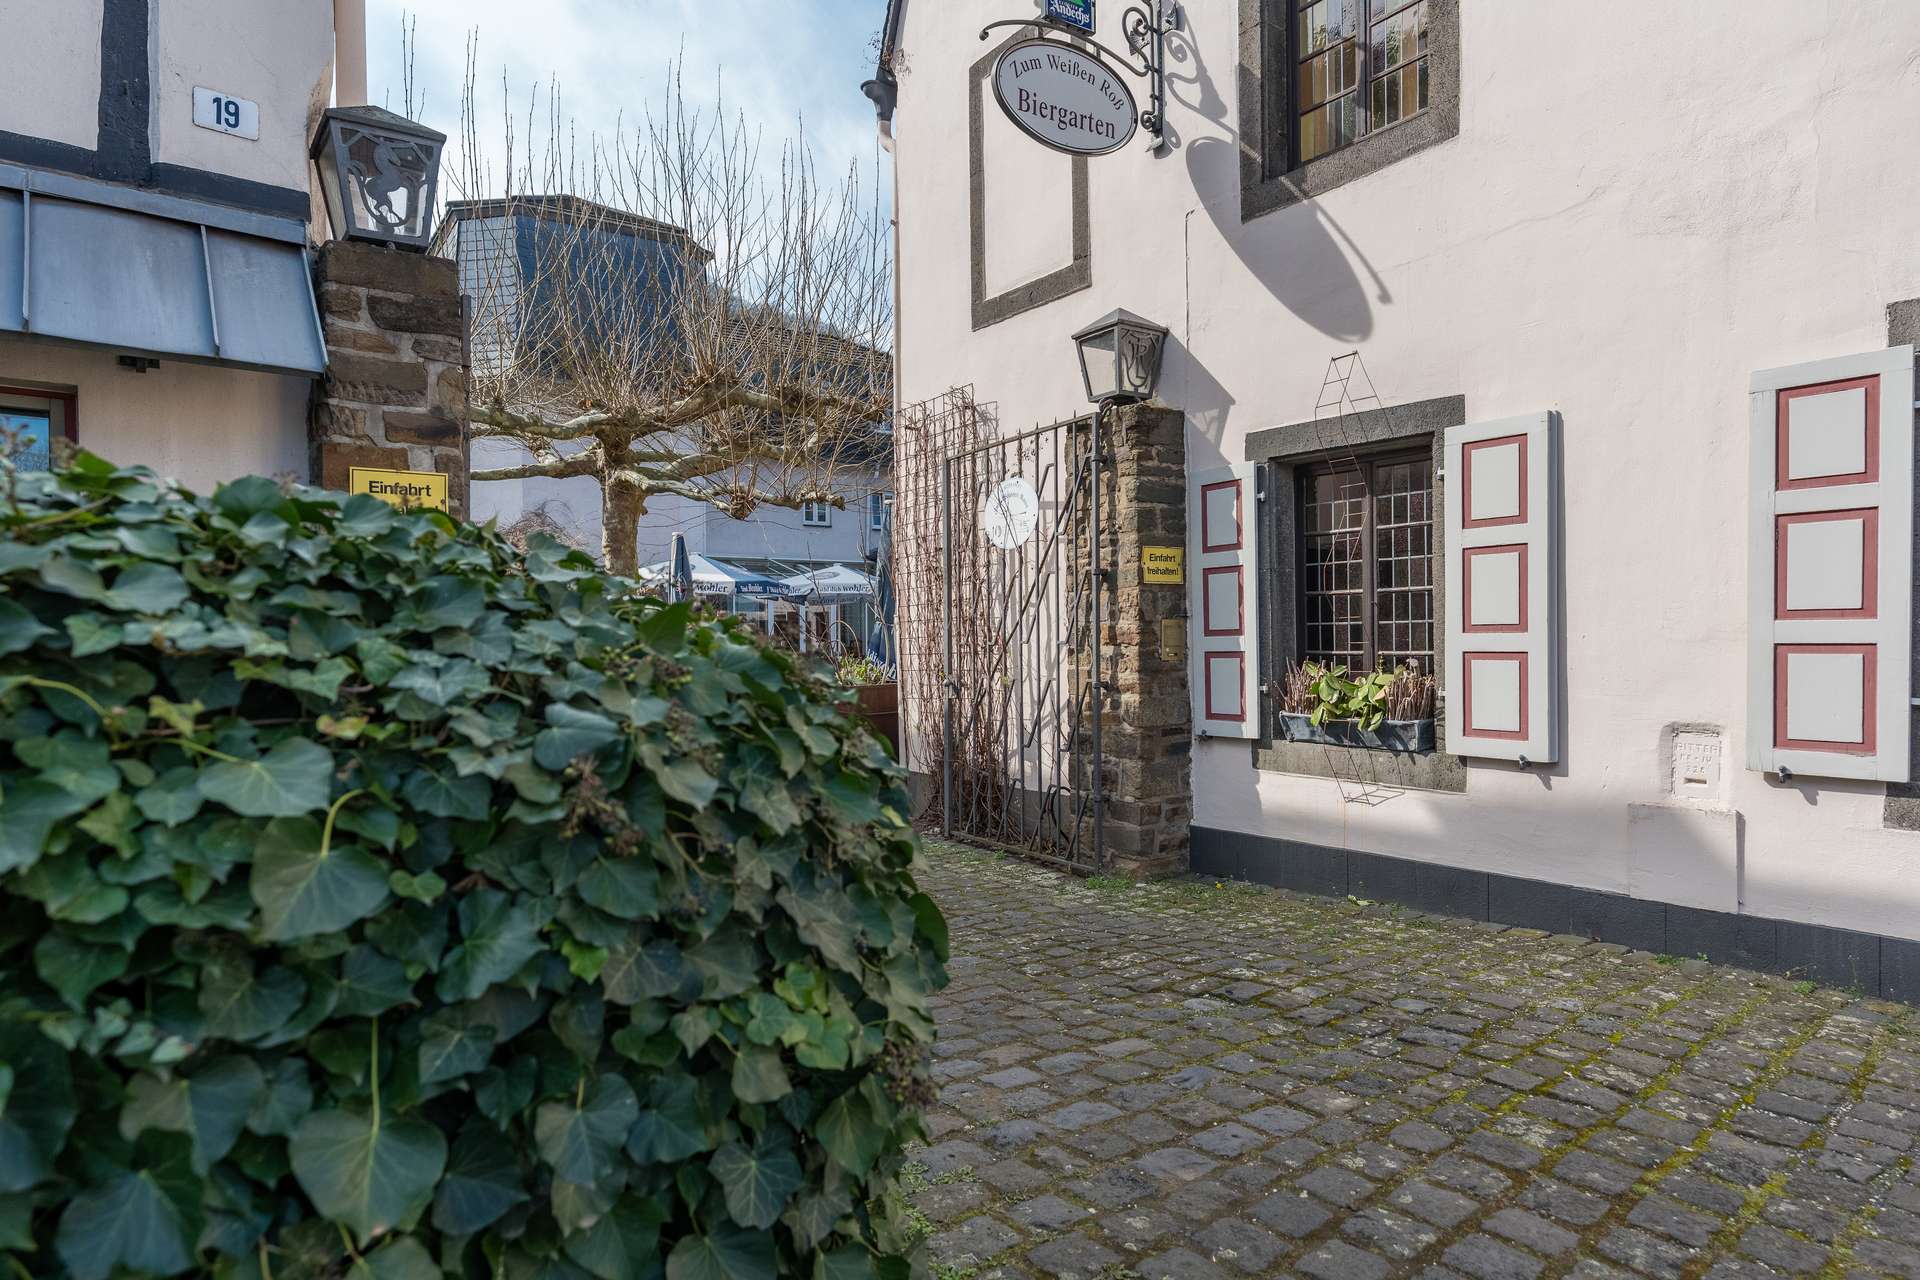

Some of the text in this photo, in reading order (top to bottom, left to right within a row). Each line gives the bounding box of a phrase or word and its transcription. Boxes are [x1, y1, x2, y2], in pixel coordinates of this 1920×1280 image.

[1009, 54, 1125, 111] Zum Weißen Roß
[212, 96, 240, 129] 19
[1017, 87, 1116, 140] Biergarten
[368, 480, 432, 497] Einfahrt
[1149, 553, 1176, 563] Einfahrt
